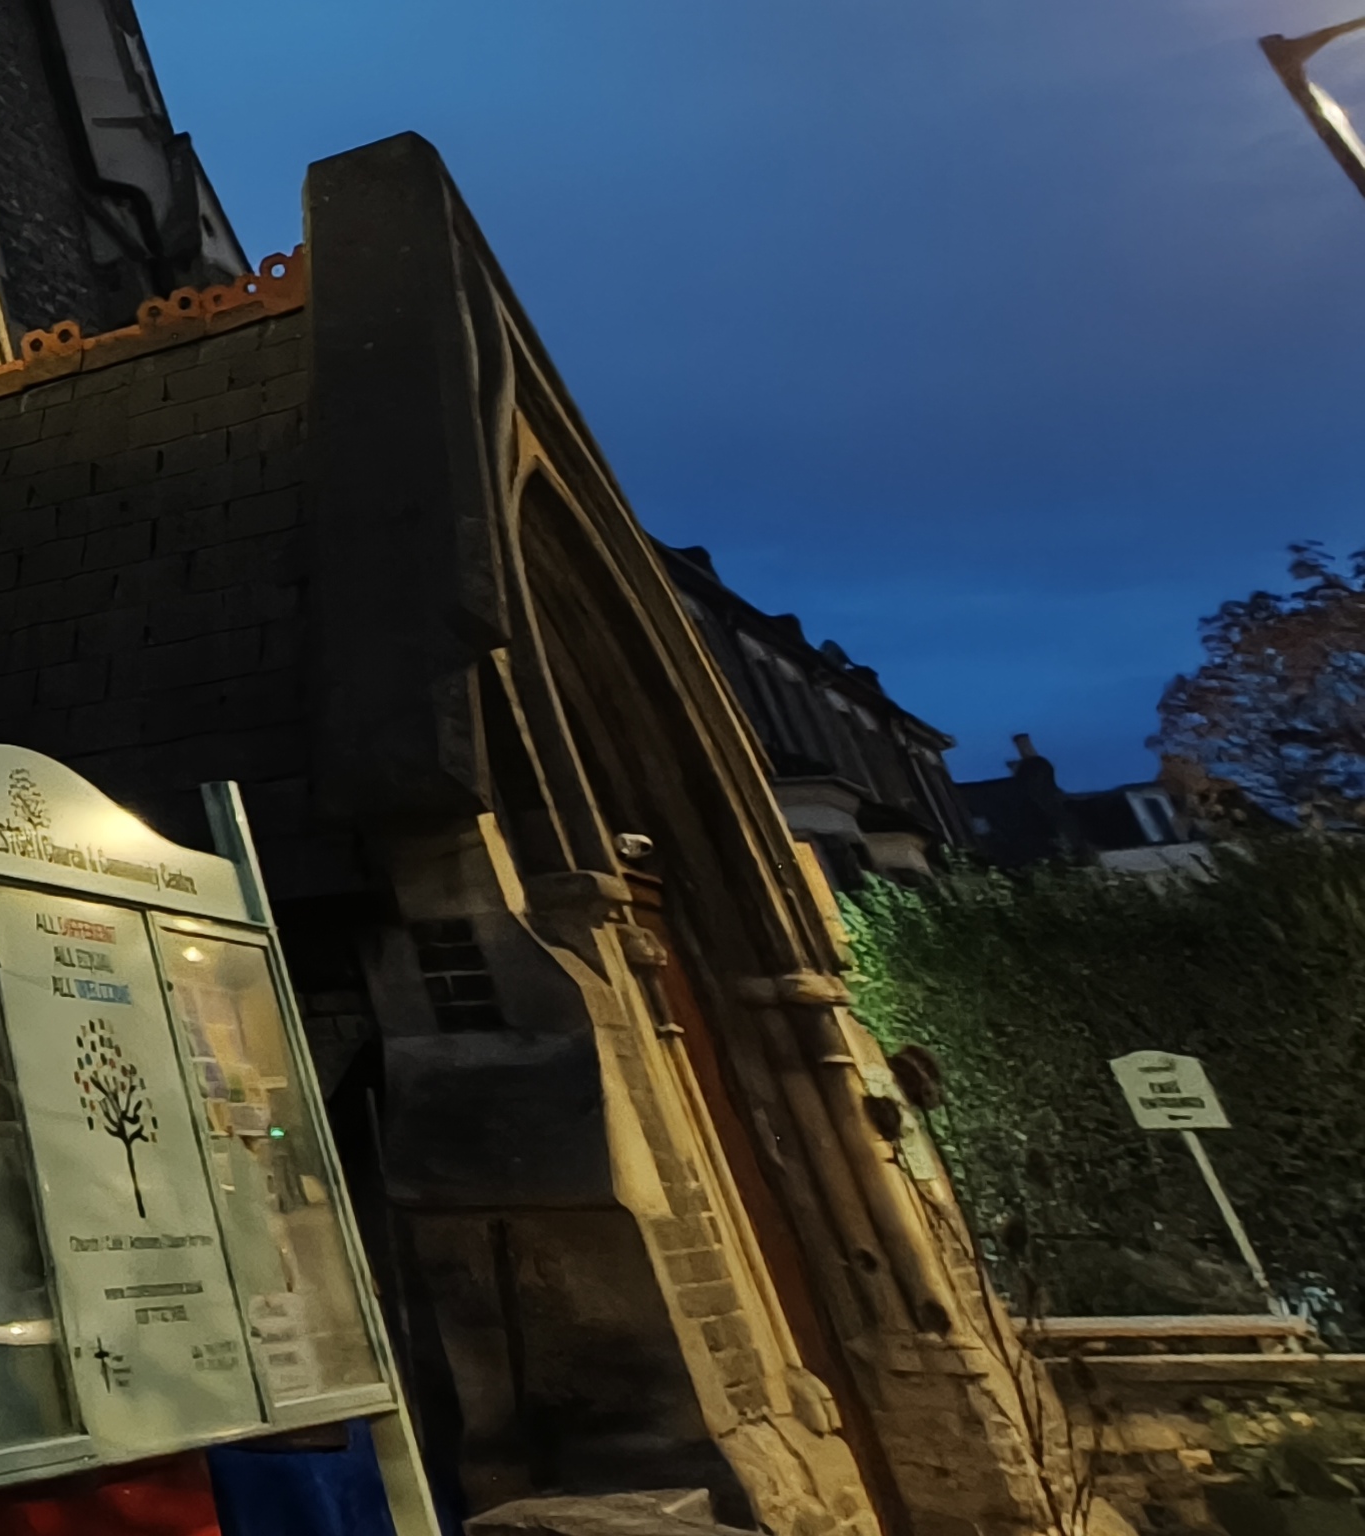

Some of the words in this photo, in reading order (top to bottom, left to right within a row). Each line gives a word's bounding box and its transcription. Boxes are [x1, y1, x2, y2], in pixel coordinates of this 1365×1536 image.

[35, 913, 65, 936] ALL
[53, 946, 76, 967] ALL
[52, 976, 76, 998] ALL
